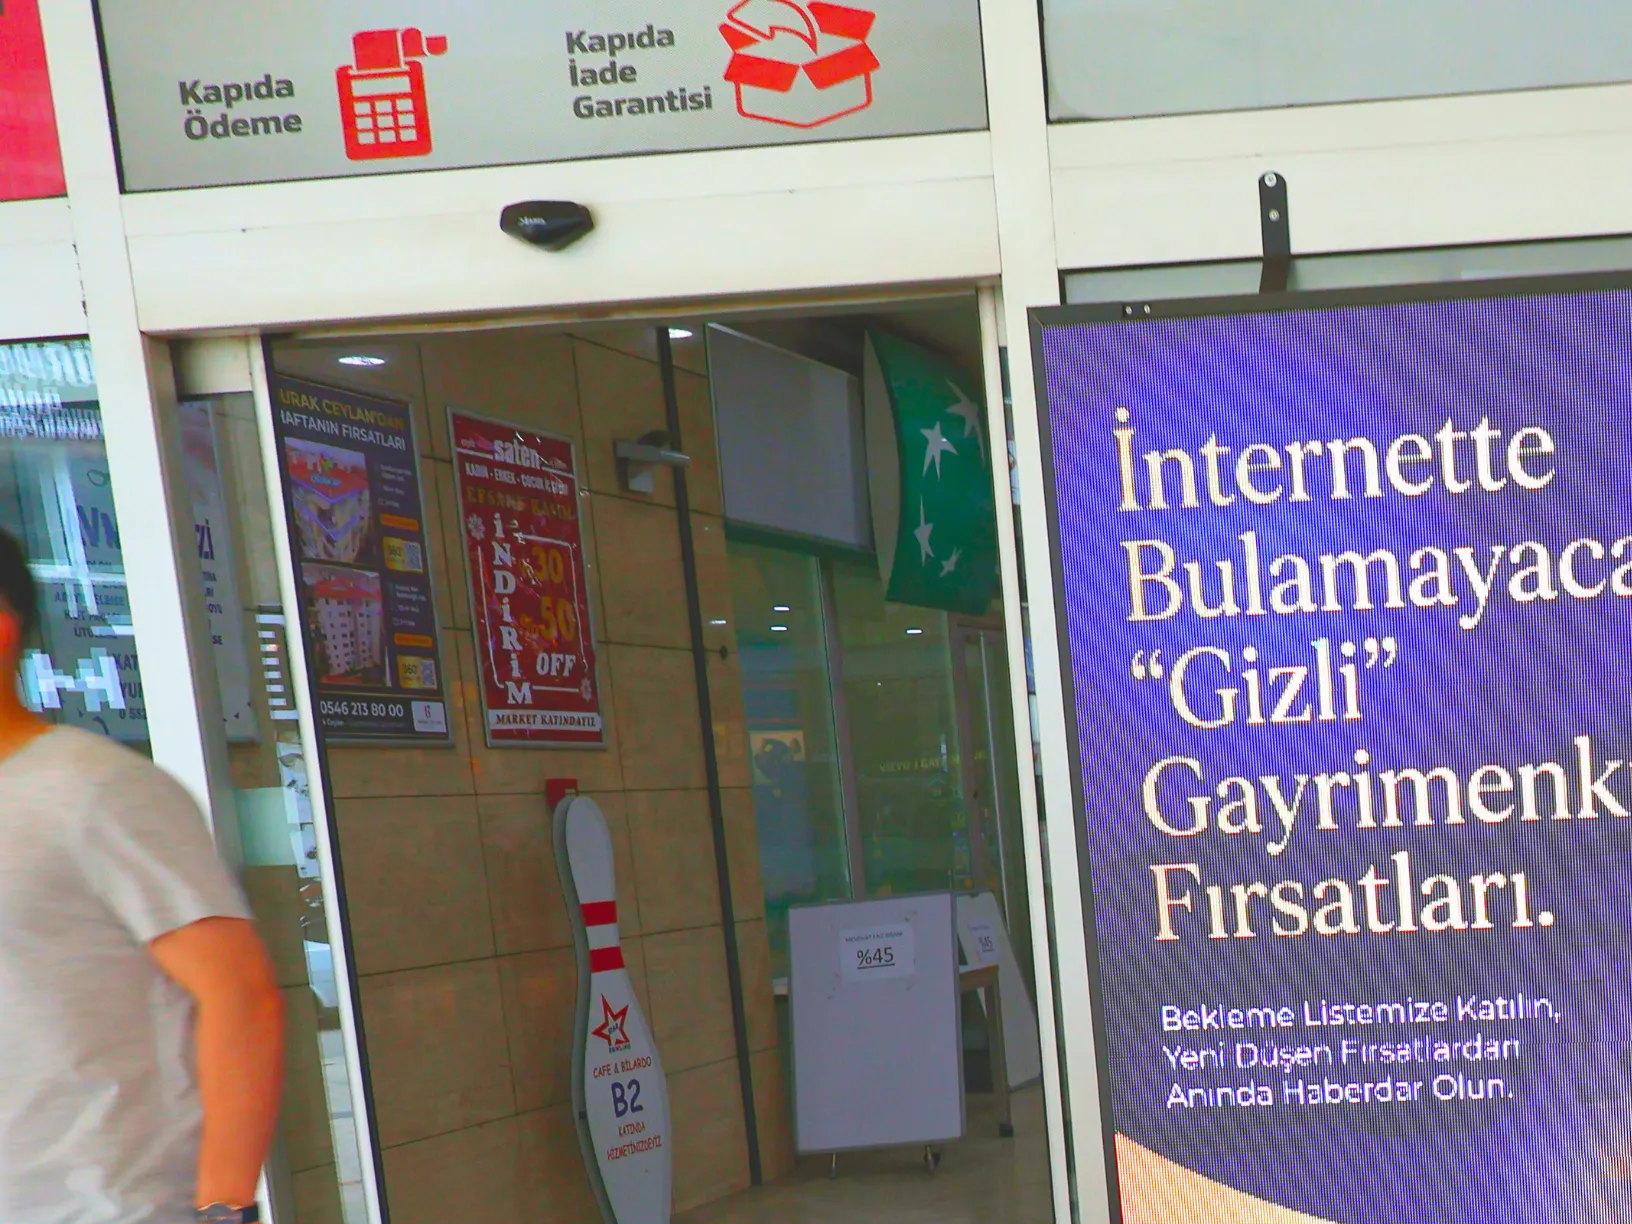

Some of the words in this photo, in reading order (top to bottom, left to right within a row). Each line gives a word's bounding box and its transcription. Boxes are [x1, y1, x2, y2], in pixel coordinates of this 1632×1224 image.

[565, 24, 676, 57] Kapıda
[568, 57, 637, 86] İade
[178, 73, 295, 108] Kapıda
[572, 85, 713, 119] Garantisi
[183, 108, 303, 140] Ödeme
[279, 388, 321, 412] URAK
[341, 424, 406, 451] FIRSATLARI
[494, 439, 541, 470] saten
[1113, 406, 1556, 513] İnternette
[536, 652, 577, 677] OFF
[1131, 636, 1398, 729] “Gizli”
[320, 700, 349, 716] 0546
[350, 702, 369, 717] 213
[371, 703, 386, 718] 80
[388, 704, 404, 718] 00
[496, 713, 537, 725] MARKET
[541, 714, 596, 727] KATINDAYIZ
[1150, 853, 1555, 942] Fırsatları.
[857, 946, 895, 968] %45
[1161, 1003, 1295, 1032] Bekleme
[1303, 1000, 1449, 1027] Listemize
[1456, 993, 1562, 1025] Katılın,
[593, 1064, 612, 1079] CAFE
[620, 1055, 652, 1073] BİLARDO
[1162, 1041, 1226, 1070] Yeni
[1235, 1041, 1333, 1074] Düşen
[1341, 1032, 1520, 1065] Fırsatlardan
[611, 1079, 644, 1118] B2
[1166, 1080, 1274, 1109] Anında
[1283, 1076, 1423, 1105] Haberdar
[1432, 1073, 1515, 1101] Olun.
